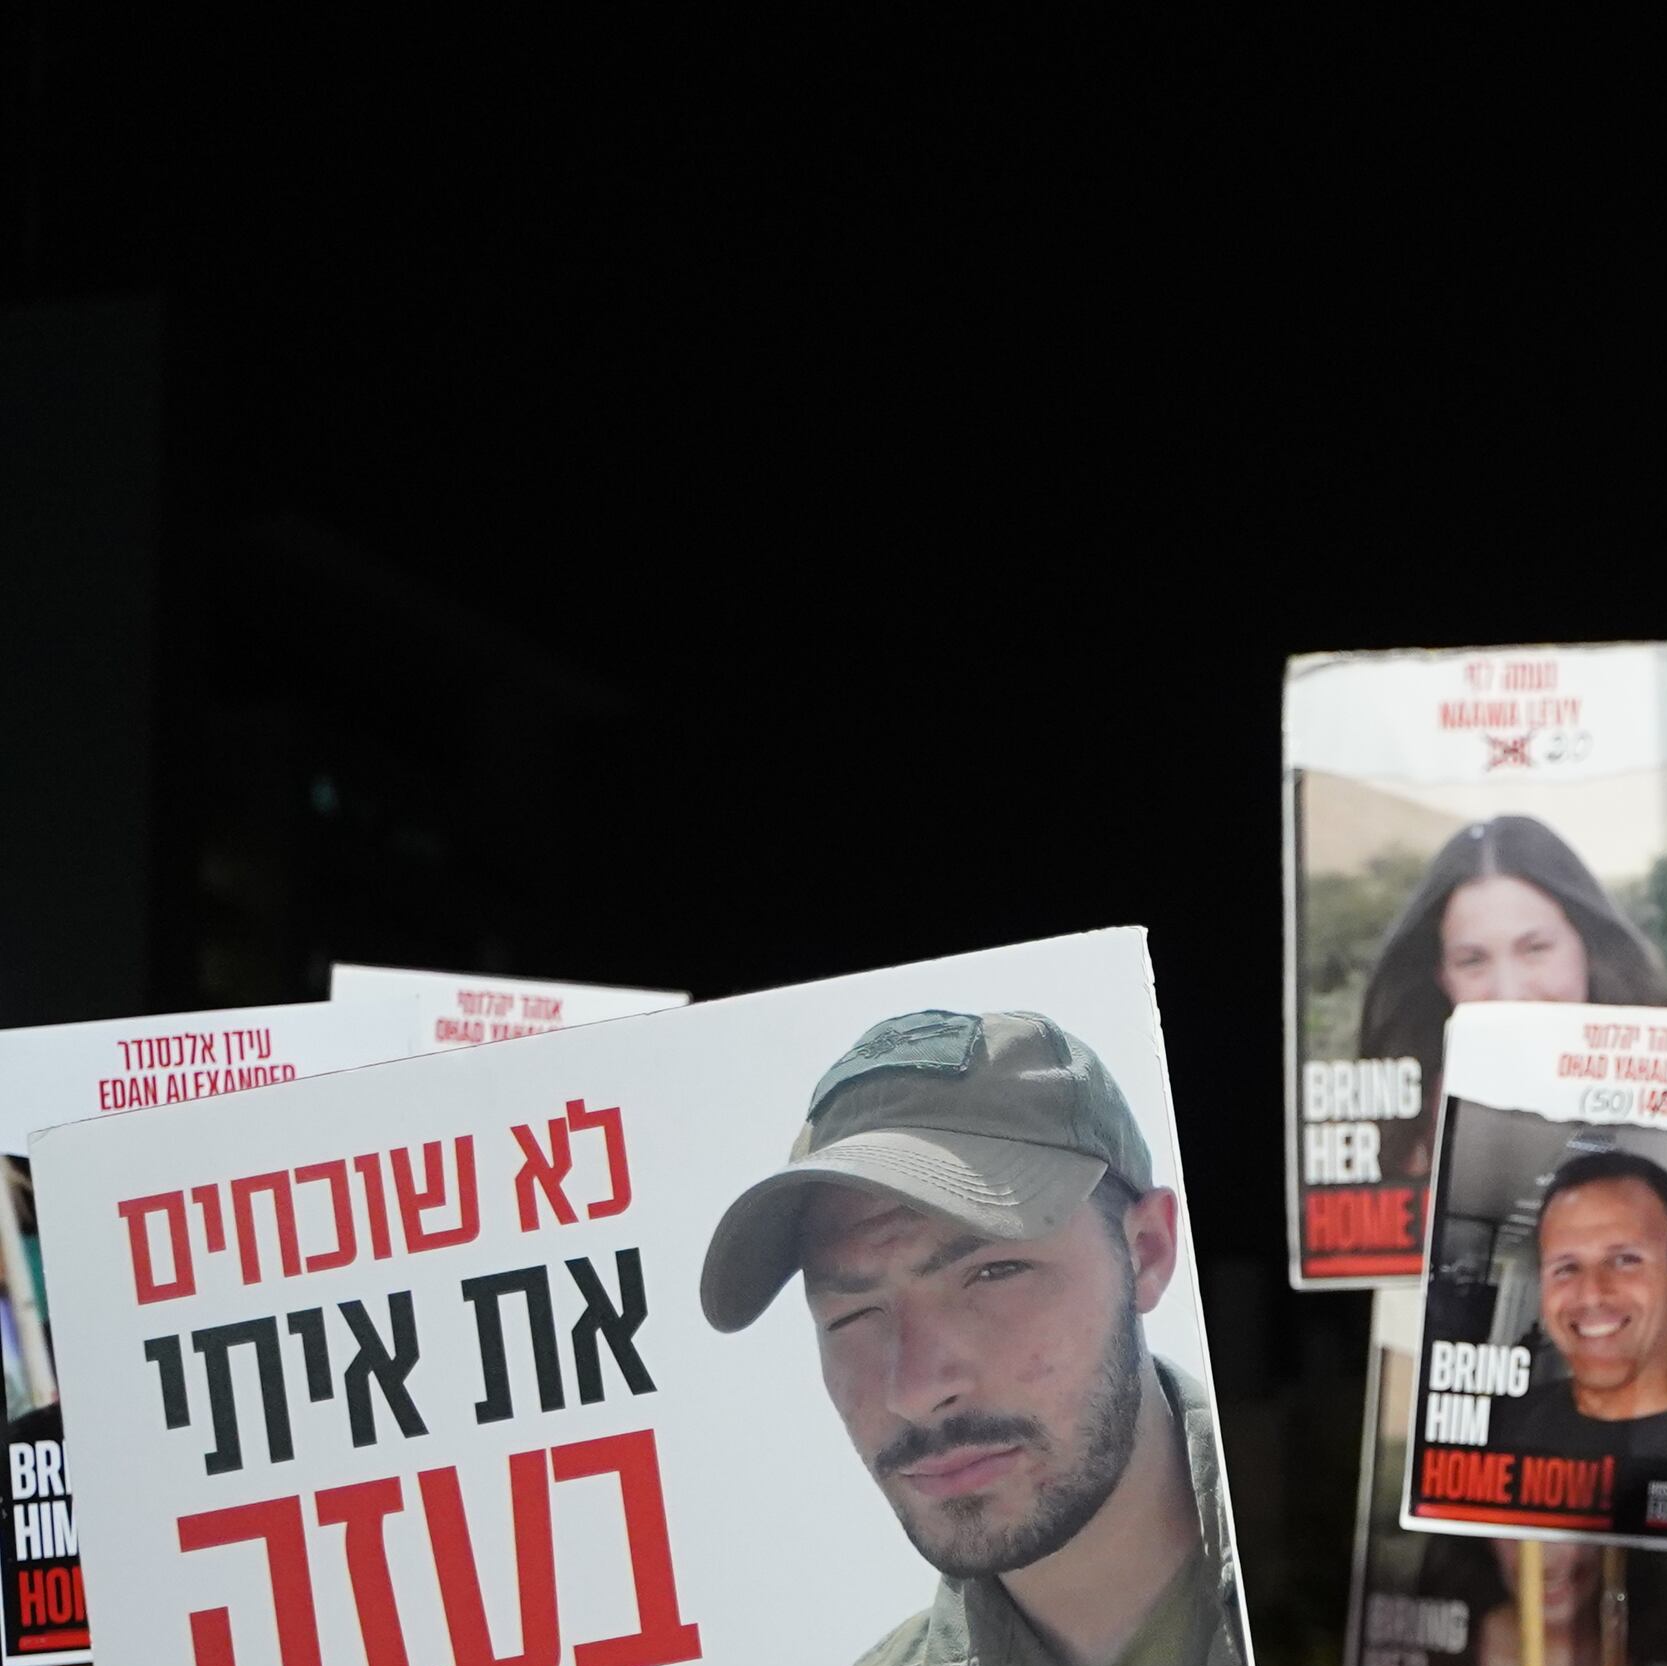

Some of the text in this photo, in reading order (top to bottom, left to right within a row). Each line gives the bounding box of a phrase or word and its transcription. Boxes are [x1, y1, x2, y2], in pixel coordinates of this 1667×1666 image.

[117, 1029, 272, 1071] עידן אלכסנדר
[98, 1076, 159, 1111] EDAN
[1302, 1056, 1423, 1122] BRING
[1303, 1120, 1382, 1185] HER
[117, 1099, 634, 1306] לא שוכחים
[1306, 1187, 1415, 1252] HOME
[144, 1247, 658, 1475] את איתי
[1430, 1340, 1531, 1398] BRING
[1425, 1392, 1491, 1448] HIM
[1422, 1448, 1513, 1504] HOME
[1519, 1455, 1616, 1511] NOW!
